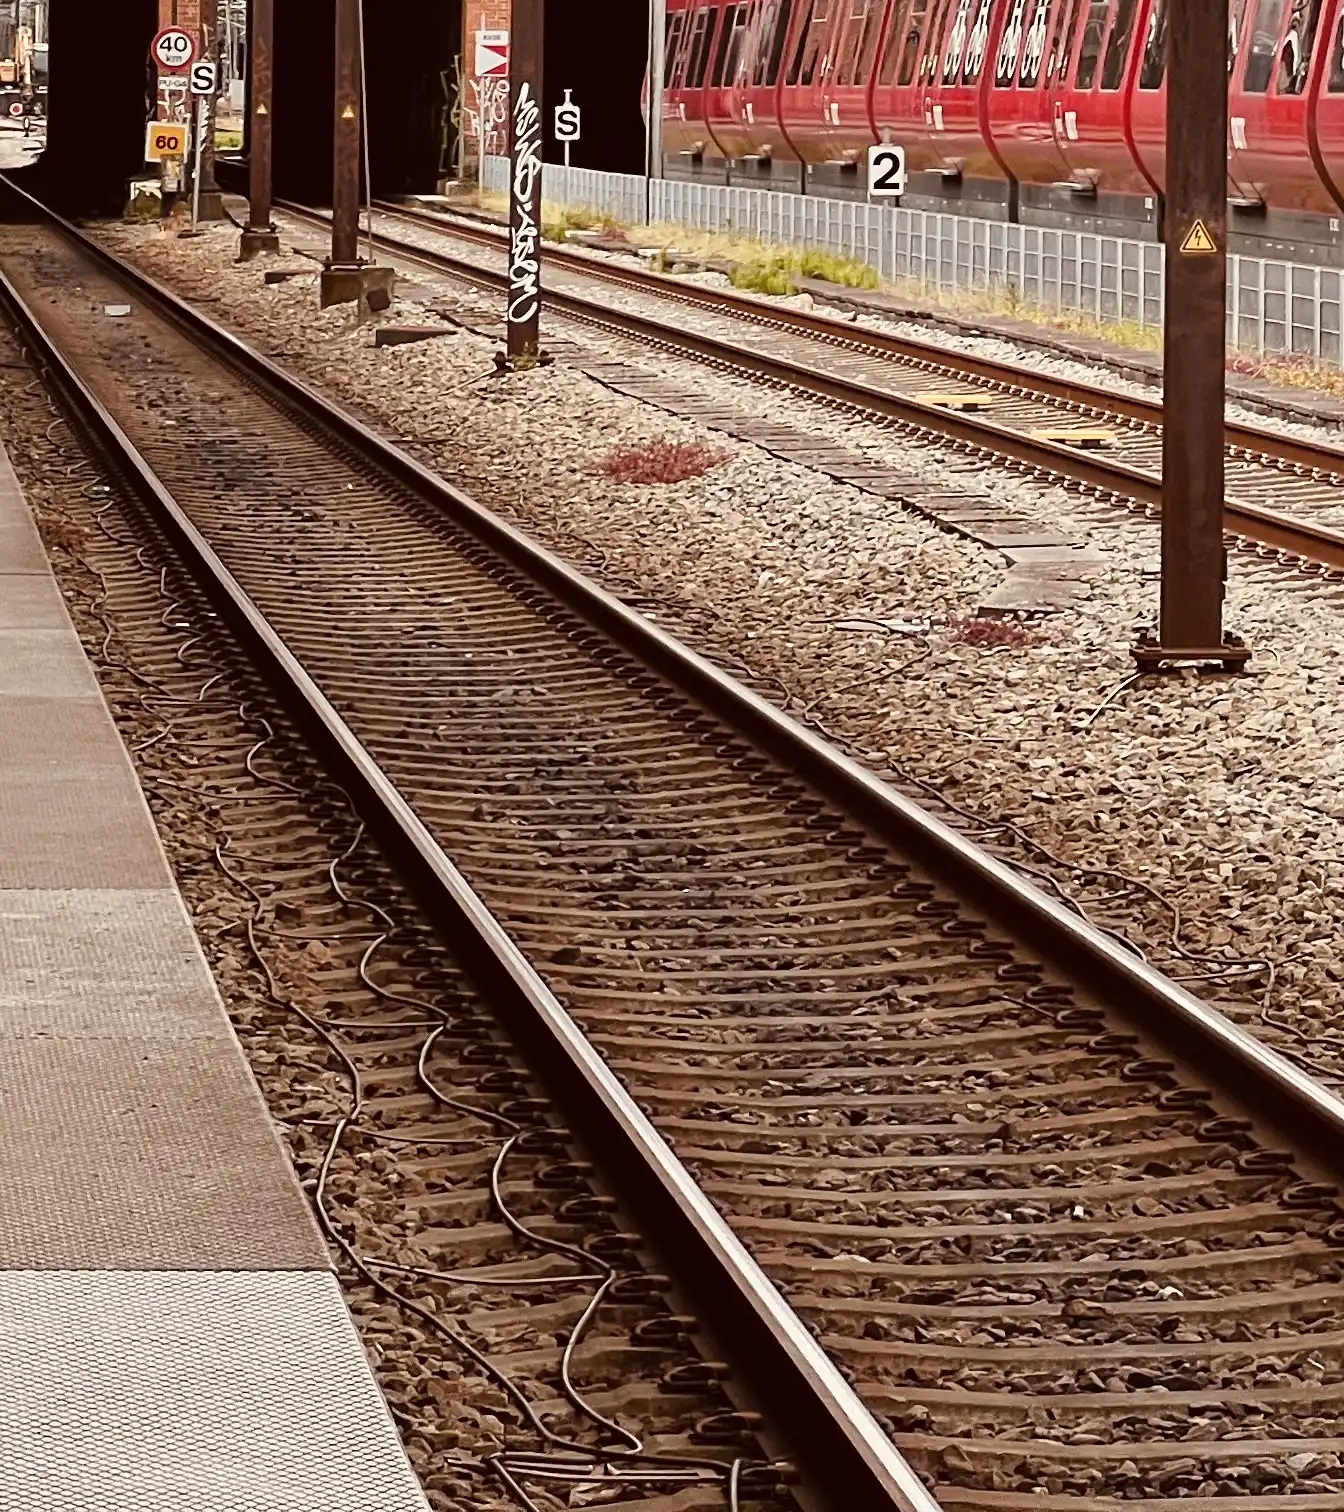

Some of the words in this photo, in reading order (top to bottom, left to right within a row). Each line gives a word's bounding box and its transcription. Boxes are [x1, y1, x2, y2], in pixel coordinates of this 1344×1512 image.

[159, 36, 188, 53] 40
[165, 55, 183, 63] km
[192, 65, 214, 91] S
[556, 110, 578, 136] S
[155, 135, 179, 150] 60
[872, 151, 900, 189] 2
